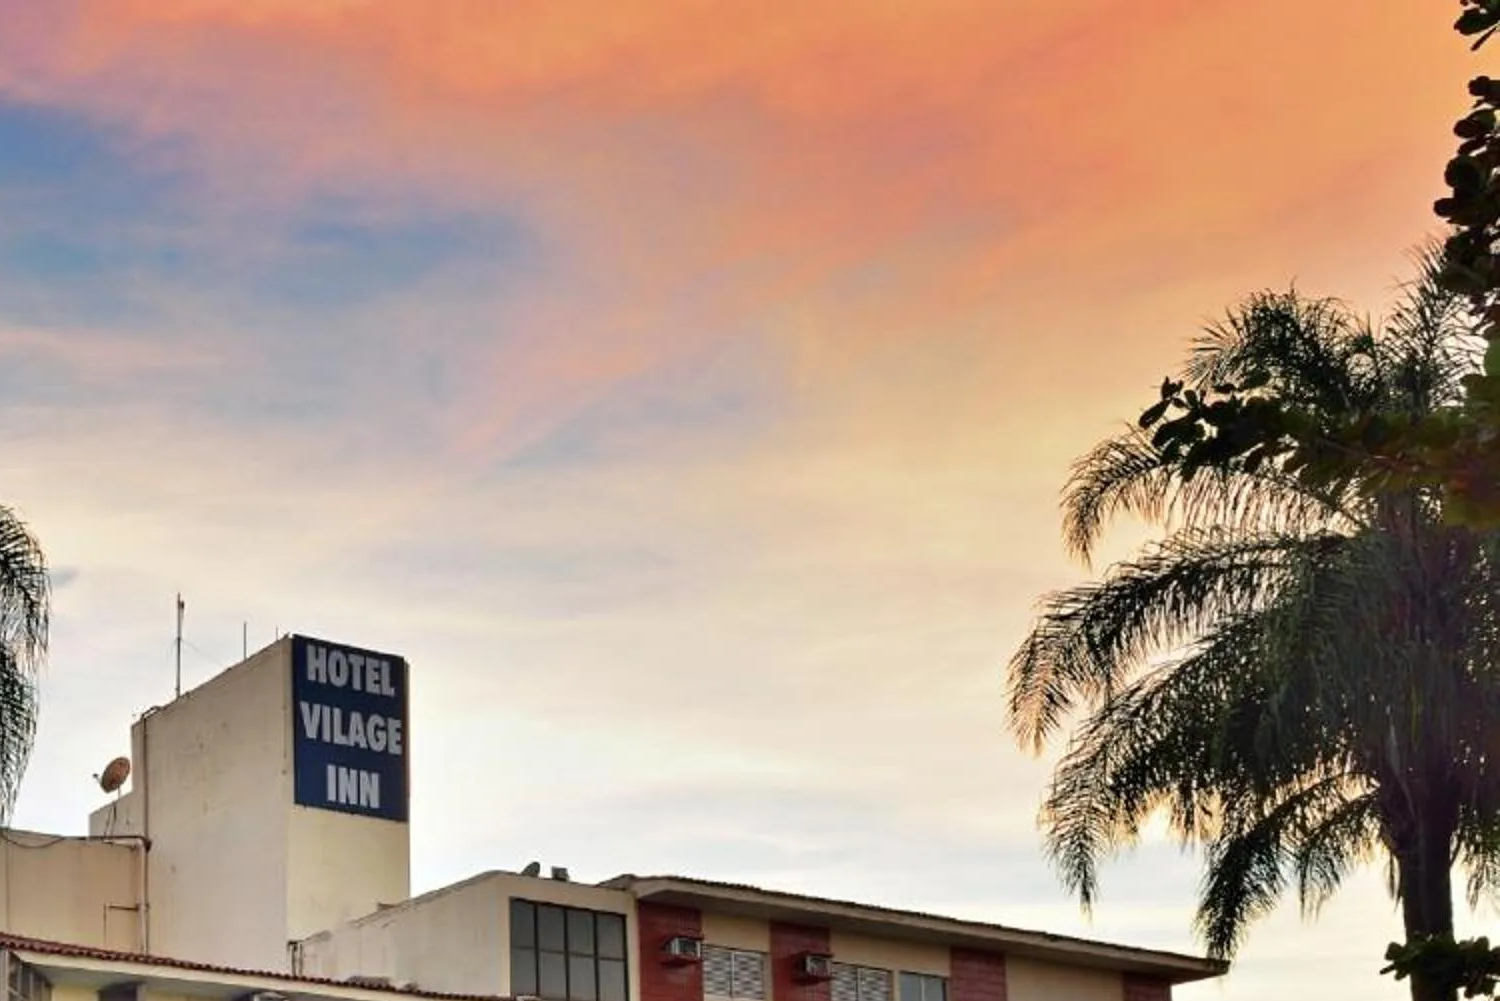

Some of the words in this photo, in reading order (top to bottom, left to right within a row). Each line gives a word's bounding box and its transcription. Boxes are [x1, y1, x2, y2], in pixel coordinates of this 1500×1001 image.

[306, 644, 396, 698] HOTEL
[300, 701, 403, 755] VILAGE
[326, 764, 381, 809] INN
